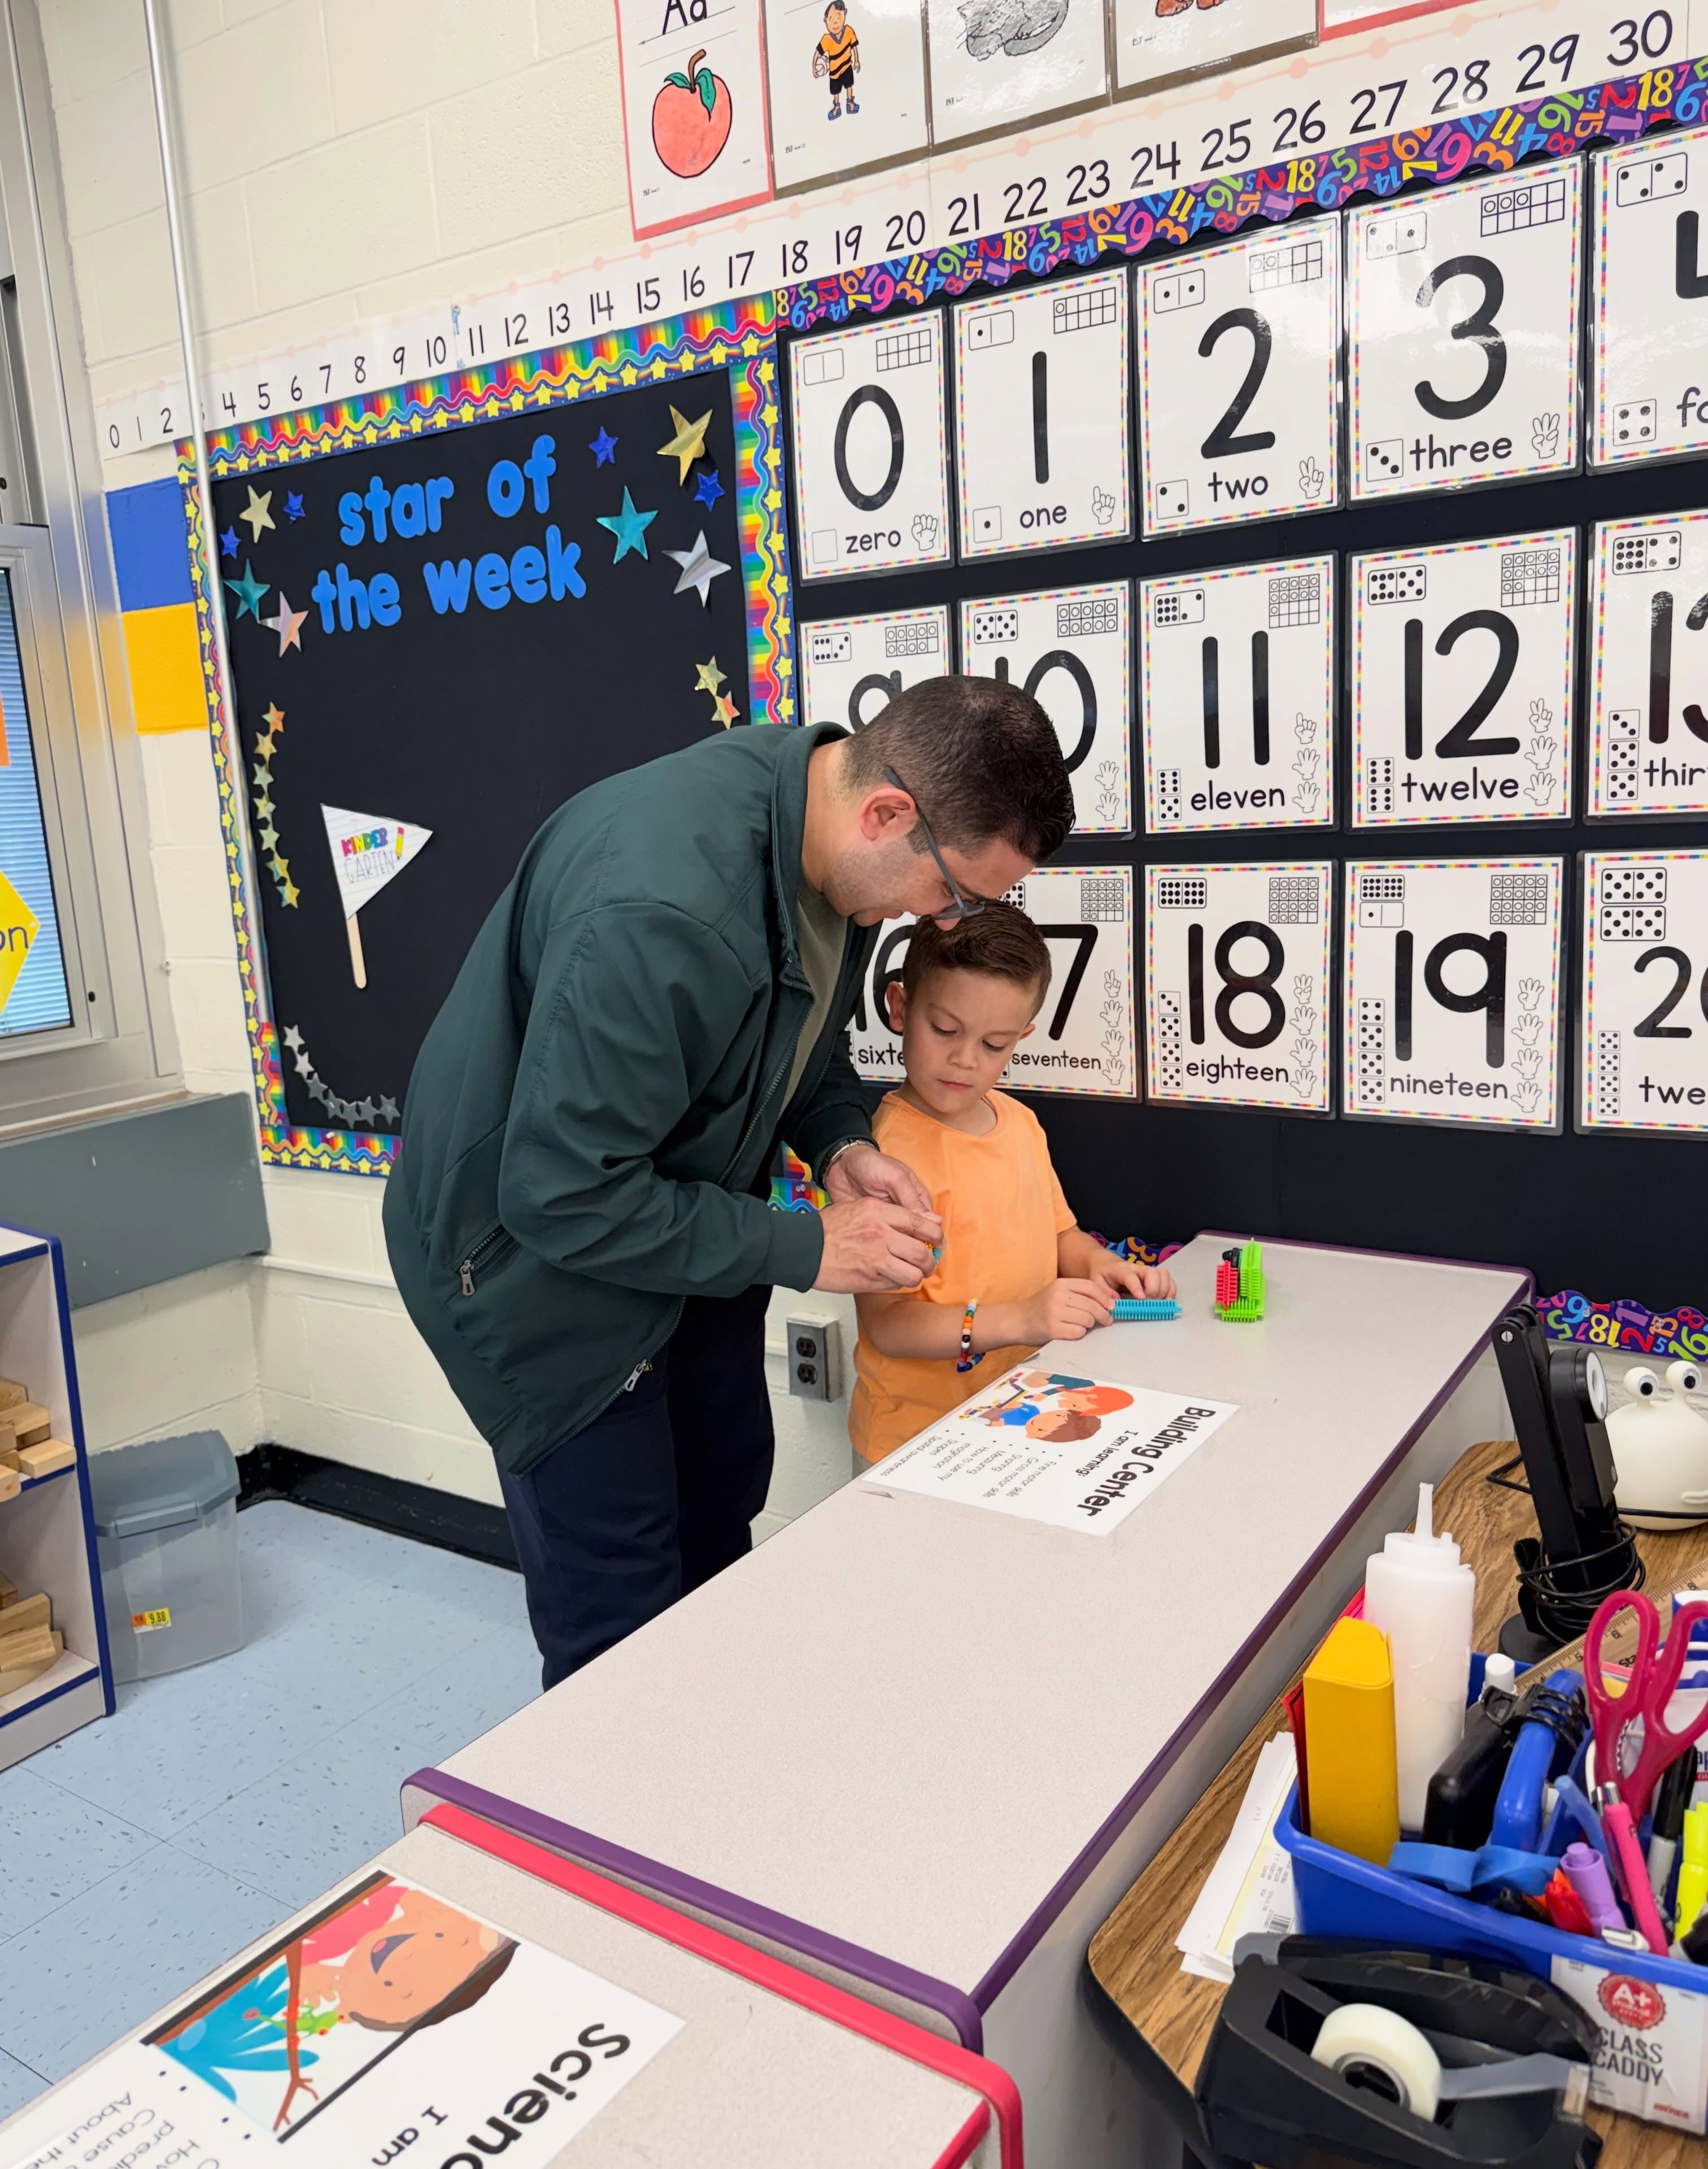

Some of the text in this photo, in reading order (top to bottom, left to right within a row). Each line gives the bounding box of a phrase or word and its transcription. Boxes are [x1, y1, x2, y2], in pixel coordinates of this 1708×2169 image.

[799, 282, 818, 310] 5
[1003, 230, 1027, 261] 18
[1039, 222, 1061, 252] 5
[1286, 159, 1316, 193] 18
[1331, 147, 1357, 183] 5
[1637, 69, 1674, 111] 18
[110, 10, 1672, 448] 0 1 2 4 5 6 7 8 9 10 11 12 13 14 15 16 17 18 19 20 21 22 23 24 25 26 27 28 29 30
[1414, 255, 1507, 420] 3
[1198, 308, 1275, 460] 2
[1032, 351, 1049, 484] 1
[834, 384, 904, 511] 0
[1409, 434, 1512, 471] three
[338, 434, 556, 546] star of
[1208, 471, 1268, 502] two
[1020, 505, 1067, 529] one
[846, 530, 901, 555] zero
[312, 525, 586, 634] the week
[1202, 630, 1269, 769] 11
[1405, 609, 1520, 760] 12
[1401, 766, 1519, 802] twelve
[1644, 757, 1708, 786] thir
[1191, 779, 1285, 812] eleven
[341, 827, 389, 857] KINDER
[345, 850, 395, 883] GARTEN
[1188, 921, 1286, 1049] 18
[1395, 930, 1507, 1069] 19
[858, 1042, 904, 1065] sixte
[1012, 1051, 1101, 1070] seventeen
[1186, 1055, 1289, 1084] eighteen
[1390, 1072, 1508, 1099] nineteen
[1112, 1436, 1128, 1447] am
[967, 1451, 1006, 1475] Measuring
[991, 1454, 1022, 1472] Sharing
[1075, 1447, 1119, 1477] learning:
[1077, 1407, 1215, 1516] Building Center
[1600, 2026, 1662, 2064] CLASS
[1594, 2049, 1664, 2086] CADDY
[67, 2090, 132, 2144] About
[84, 2109, 155, 2162] Cause
[371, 2106, 448, 2166] I am
